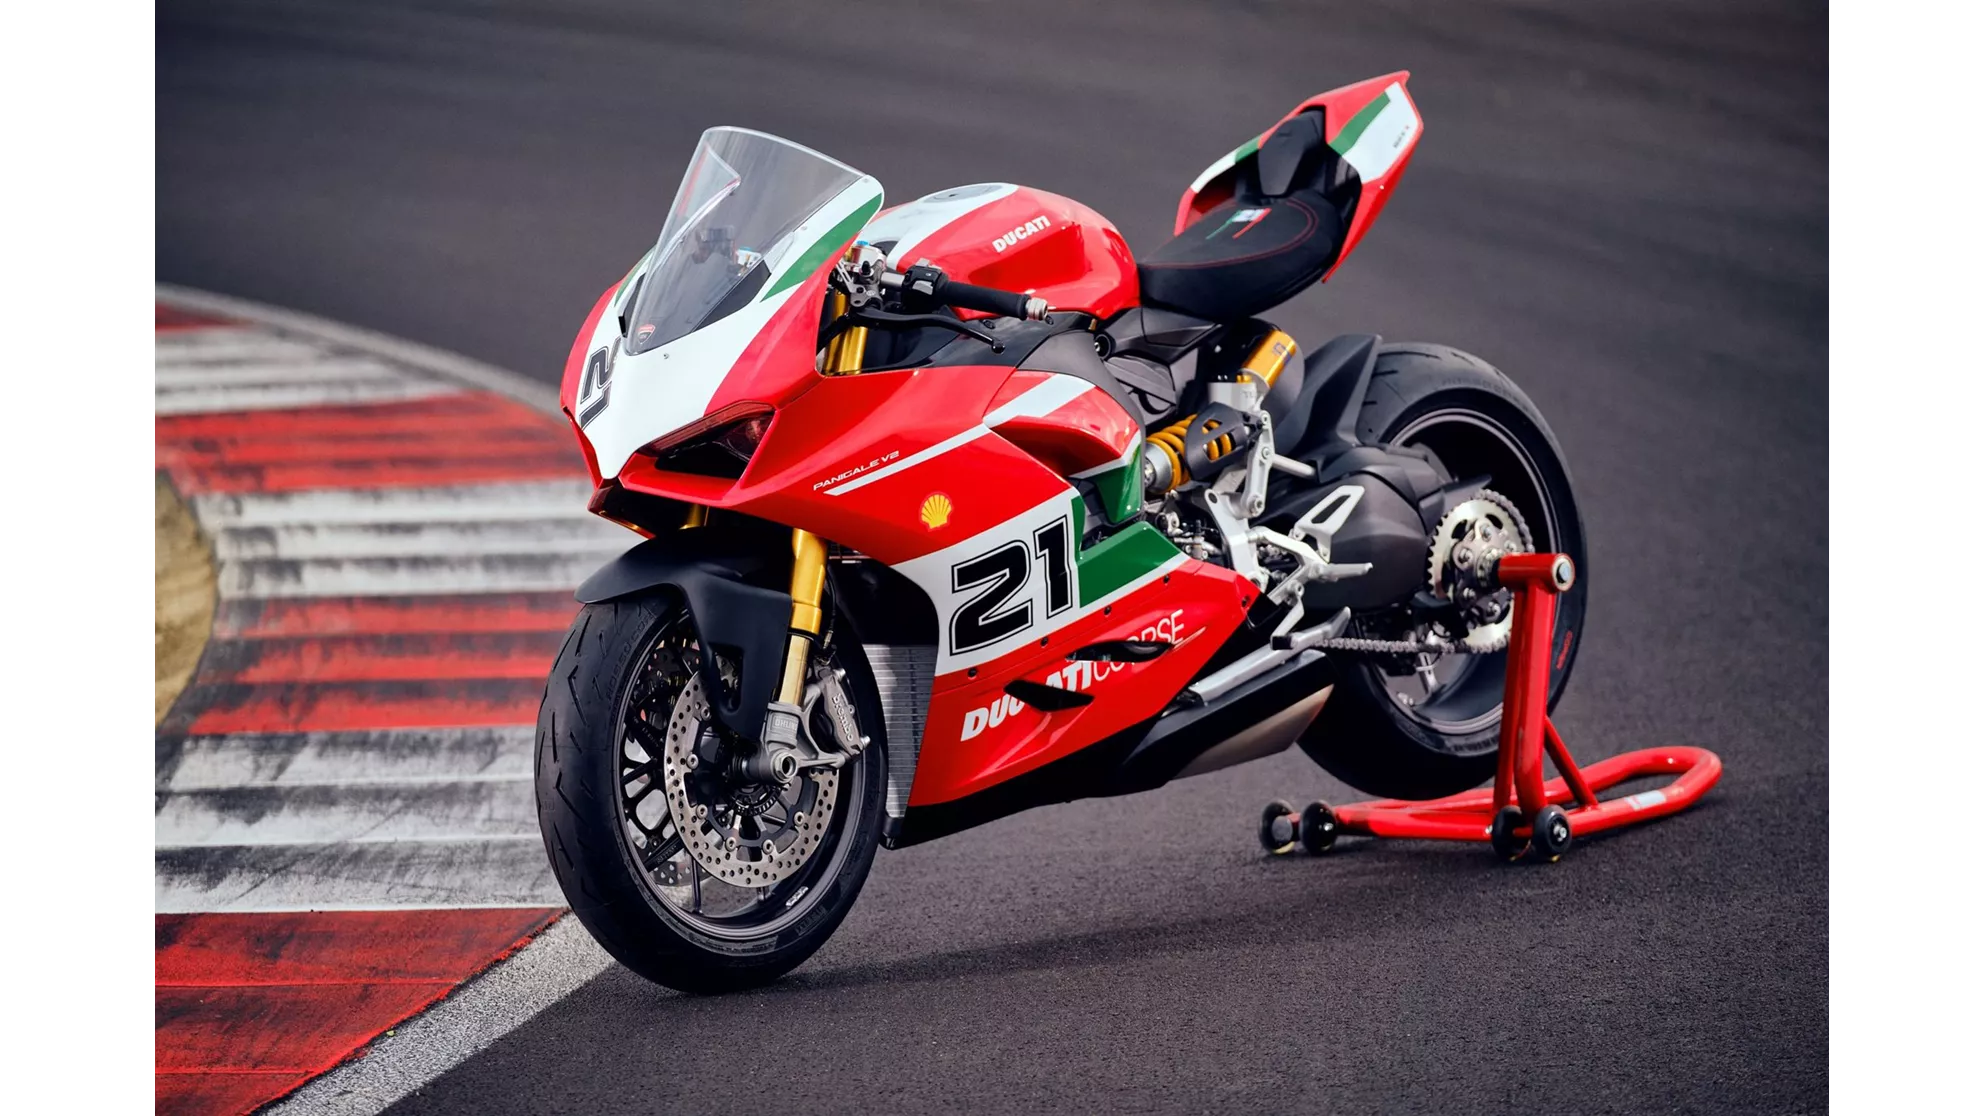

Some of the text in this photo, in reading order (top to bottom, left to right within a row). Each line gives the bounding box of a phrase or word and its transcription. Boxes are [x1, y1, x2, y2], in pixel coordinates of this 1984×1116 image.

[992, 215, 1051, 253] DUCATI
[813, 450, 900, 491] PANIGALE V2
[949, 514, 1073, 656] 21
[832, 693, 854, 741] brembo
